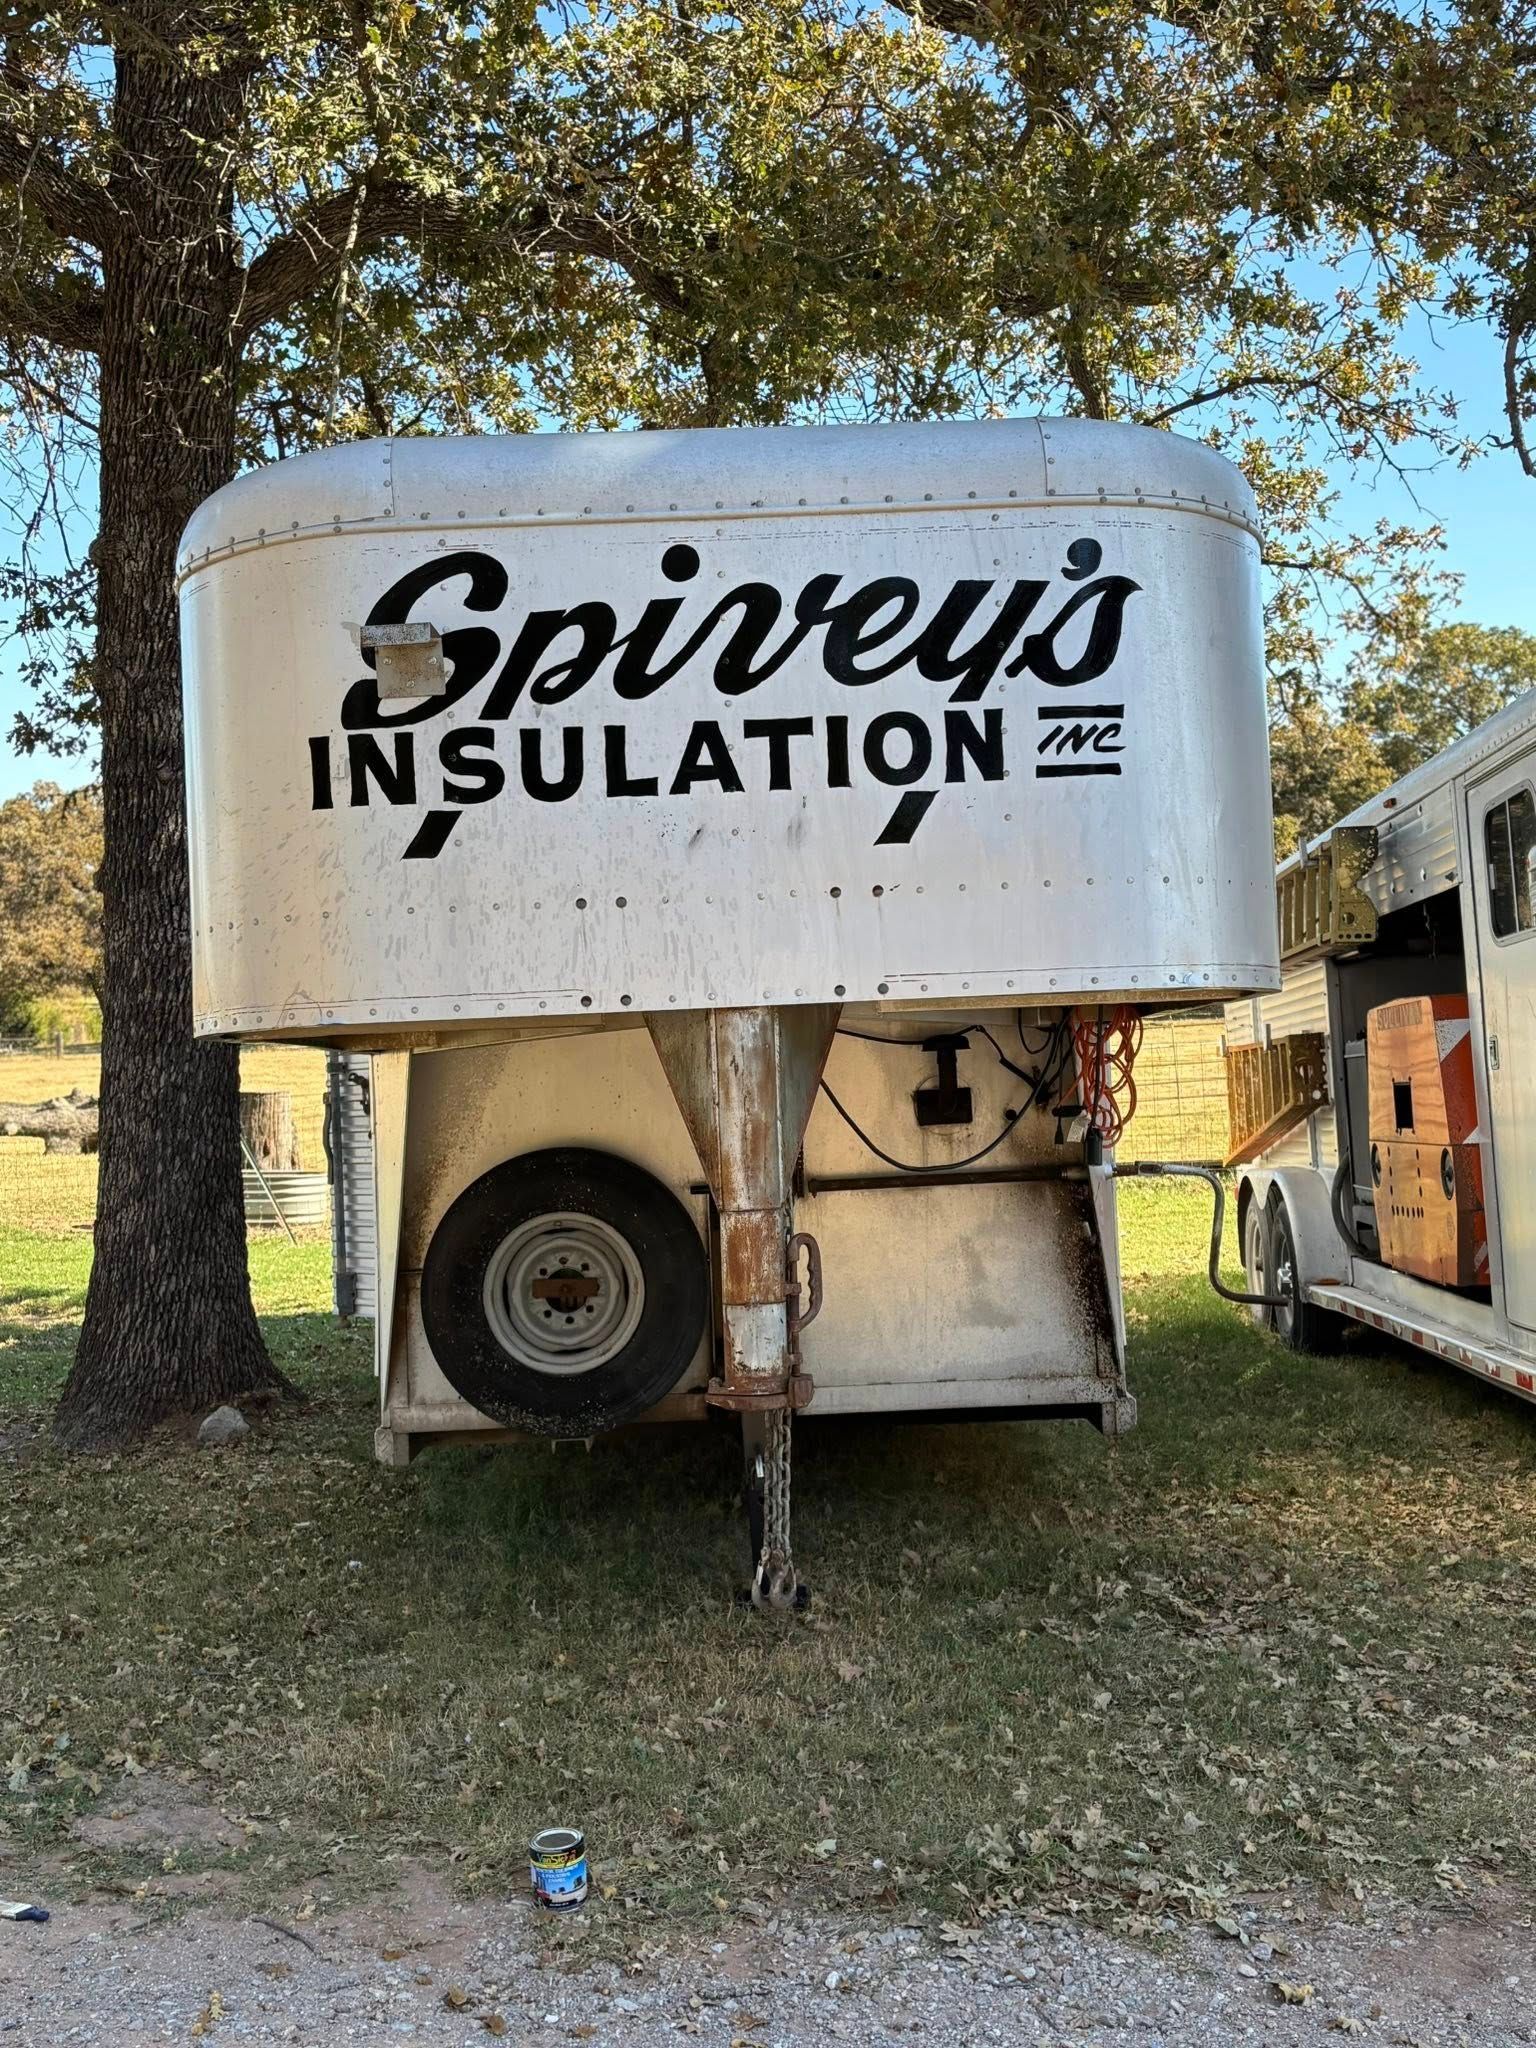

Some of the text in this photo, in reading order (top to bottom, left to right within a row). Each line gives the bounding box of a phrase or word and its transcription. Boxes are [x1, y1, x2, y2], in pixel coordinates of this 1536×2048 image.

[340, 538, 1142, 859] Spivey's
[1038, 722, 1126, 754] INC
[309, 708, 1004, 809] INSULATION
